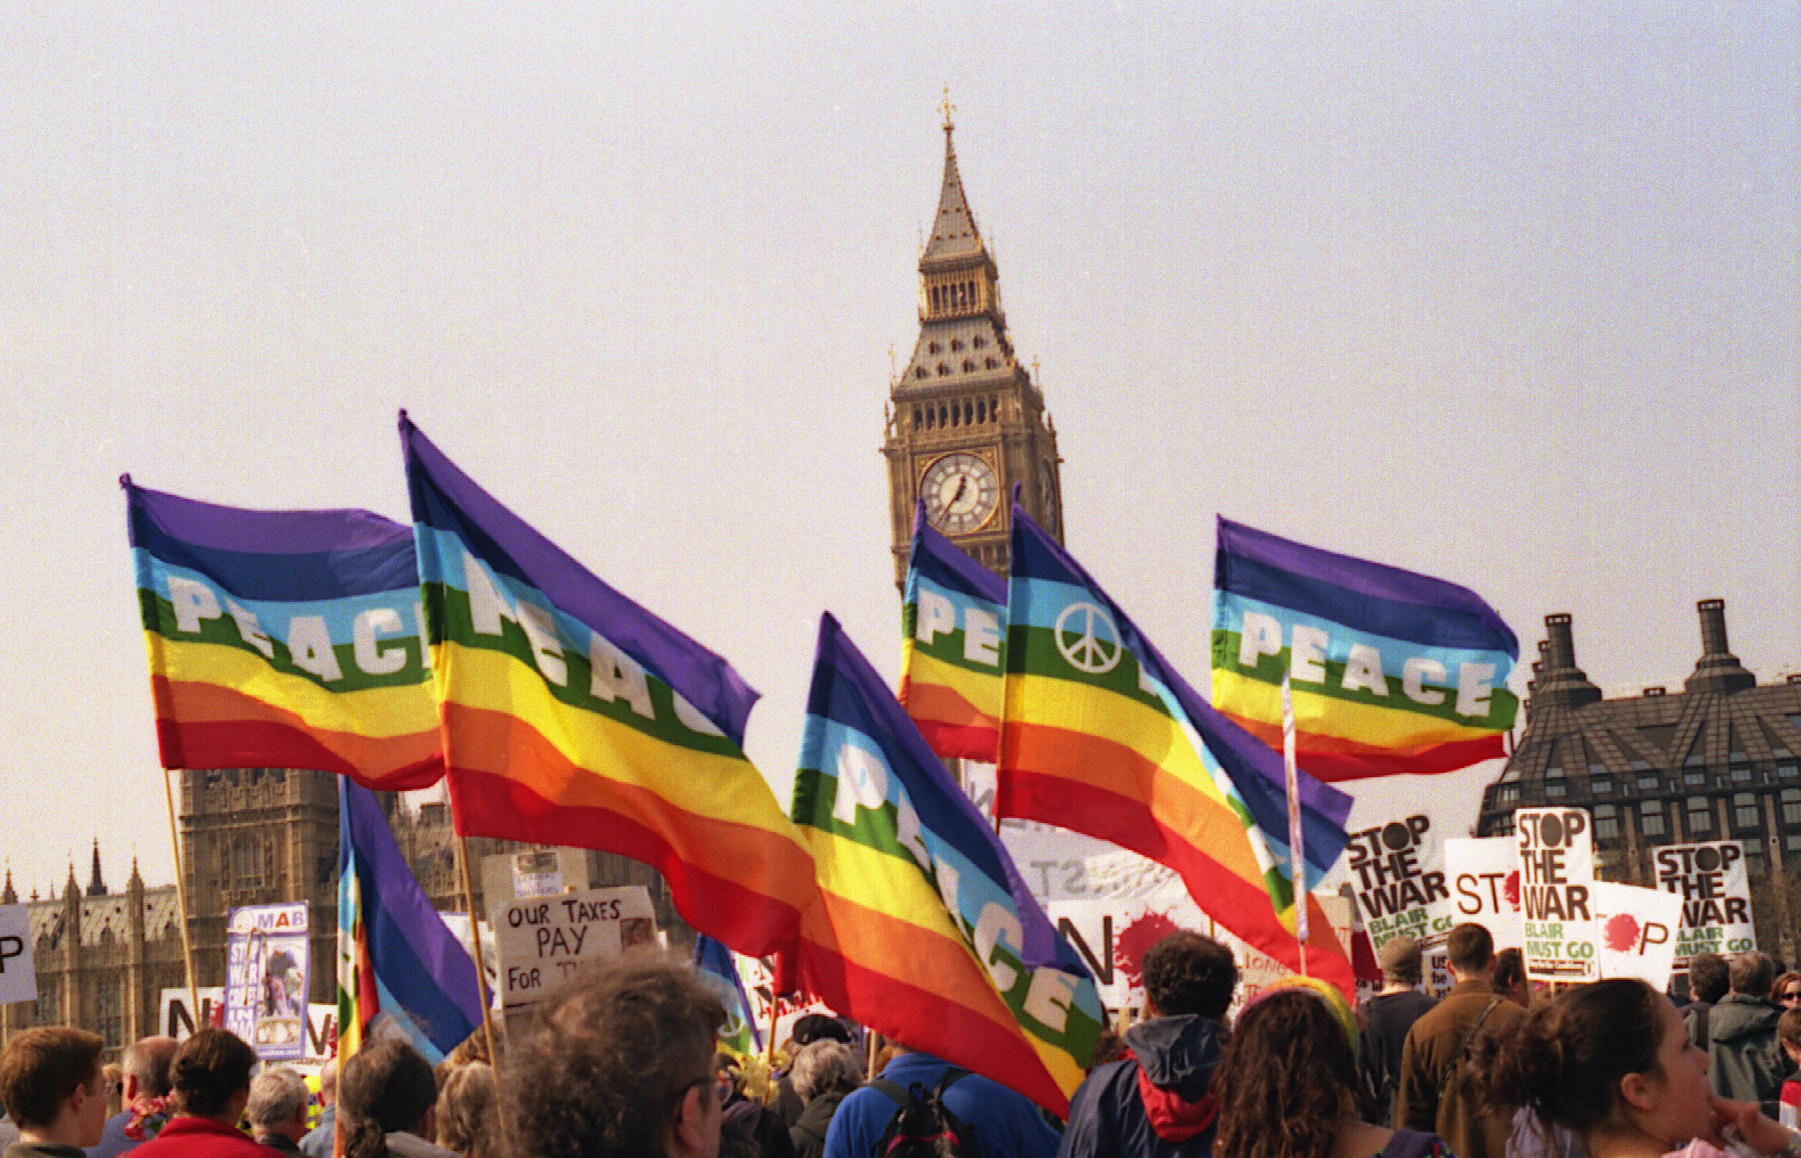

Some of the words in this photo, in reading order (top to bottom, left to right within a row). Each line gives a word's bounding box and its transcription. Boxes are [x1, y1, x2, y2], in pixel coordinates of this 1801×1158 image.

[166, 576, 433, 682] PEAC
[1238, 611, 1497, 718] PEACE
[1347, 815, 1430, 864] STOP
[1520, 811, 1586, 849] STOP
[1351, 847, 1423, 890] THE
[1520, 849, 1568, 884] THE
[1657, 844, 1741, 876] STOP
[1360, 871, 1450, 919] WAR
[1660, 872, 1726, 901] THE
[508, 904, 550, 929] OUR
[561, 899, 622, 924] TAXES
[1523, 885, 1592, 921] WAR
[258, 911, 305, 929] MAB
[1525, 922, 1564, 939] BLAIR
[1677, 927, 1724, 943] LAIR
[536, 925, 588, 958] PAY
[1526, 940, 1563, 958] MUST
[1567, 941, 1595, 959] GO
[1727, 938, 1753, 951] GO
[508, 966, 542, 991] FOR
